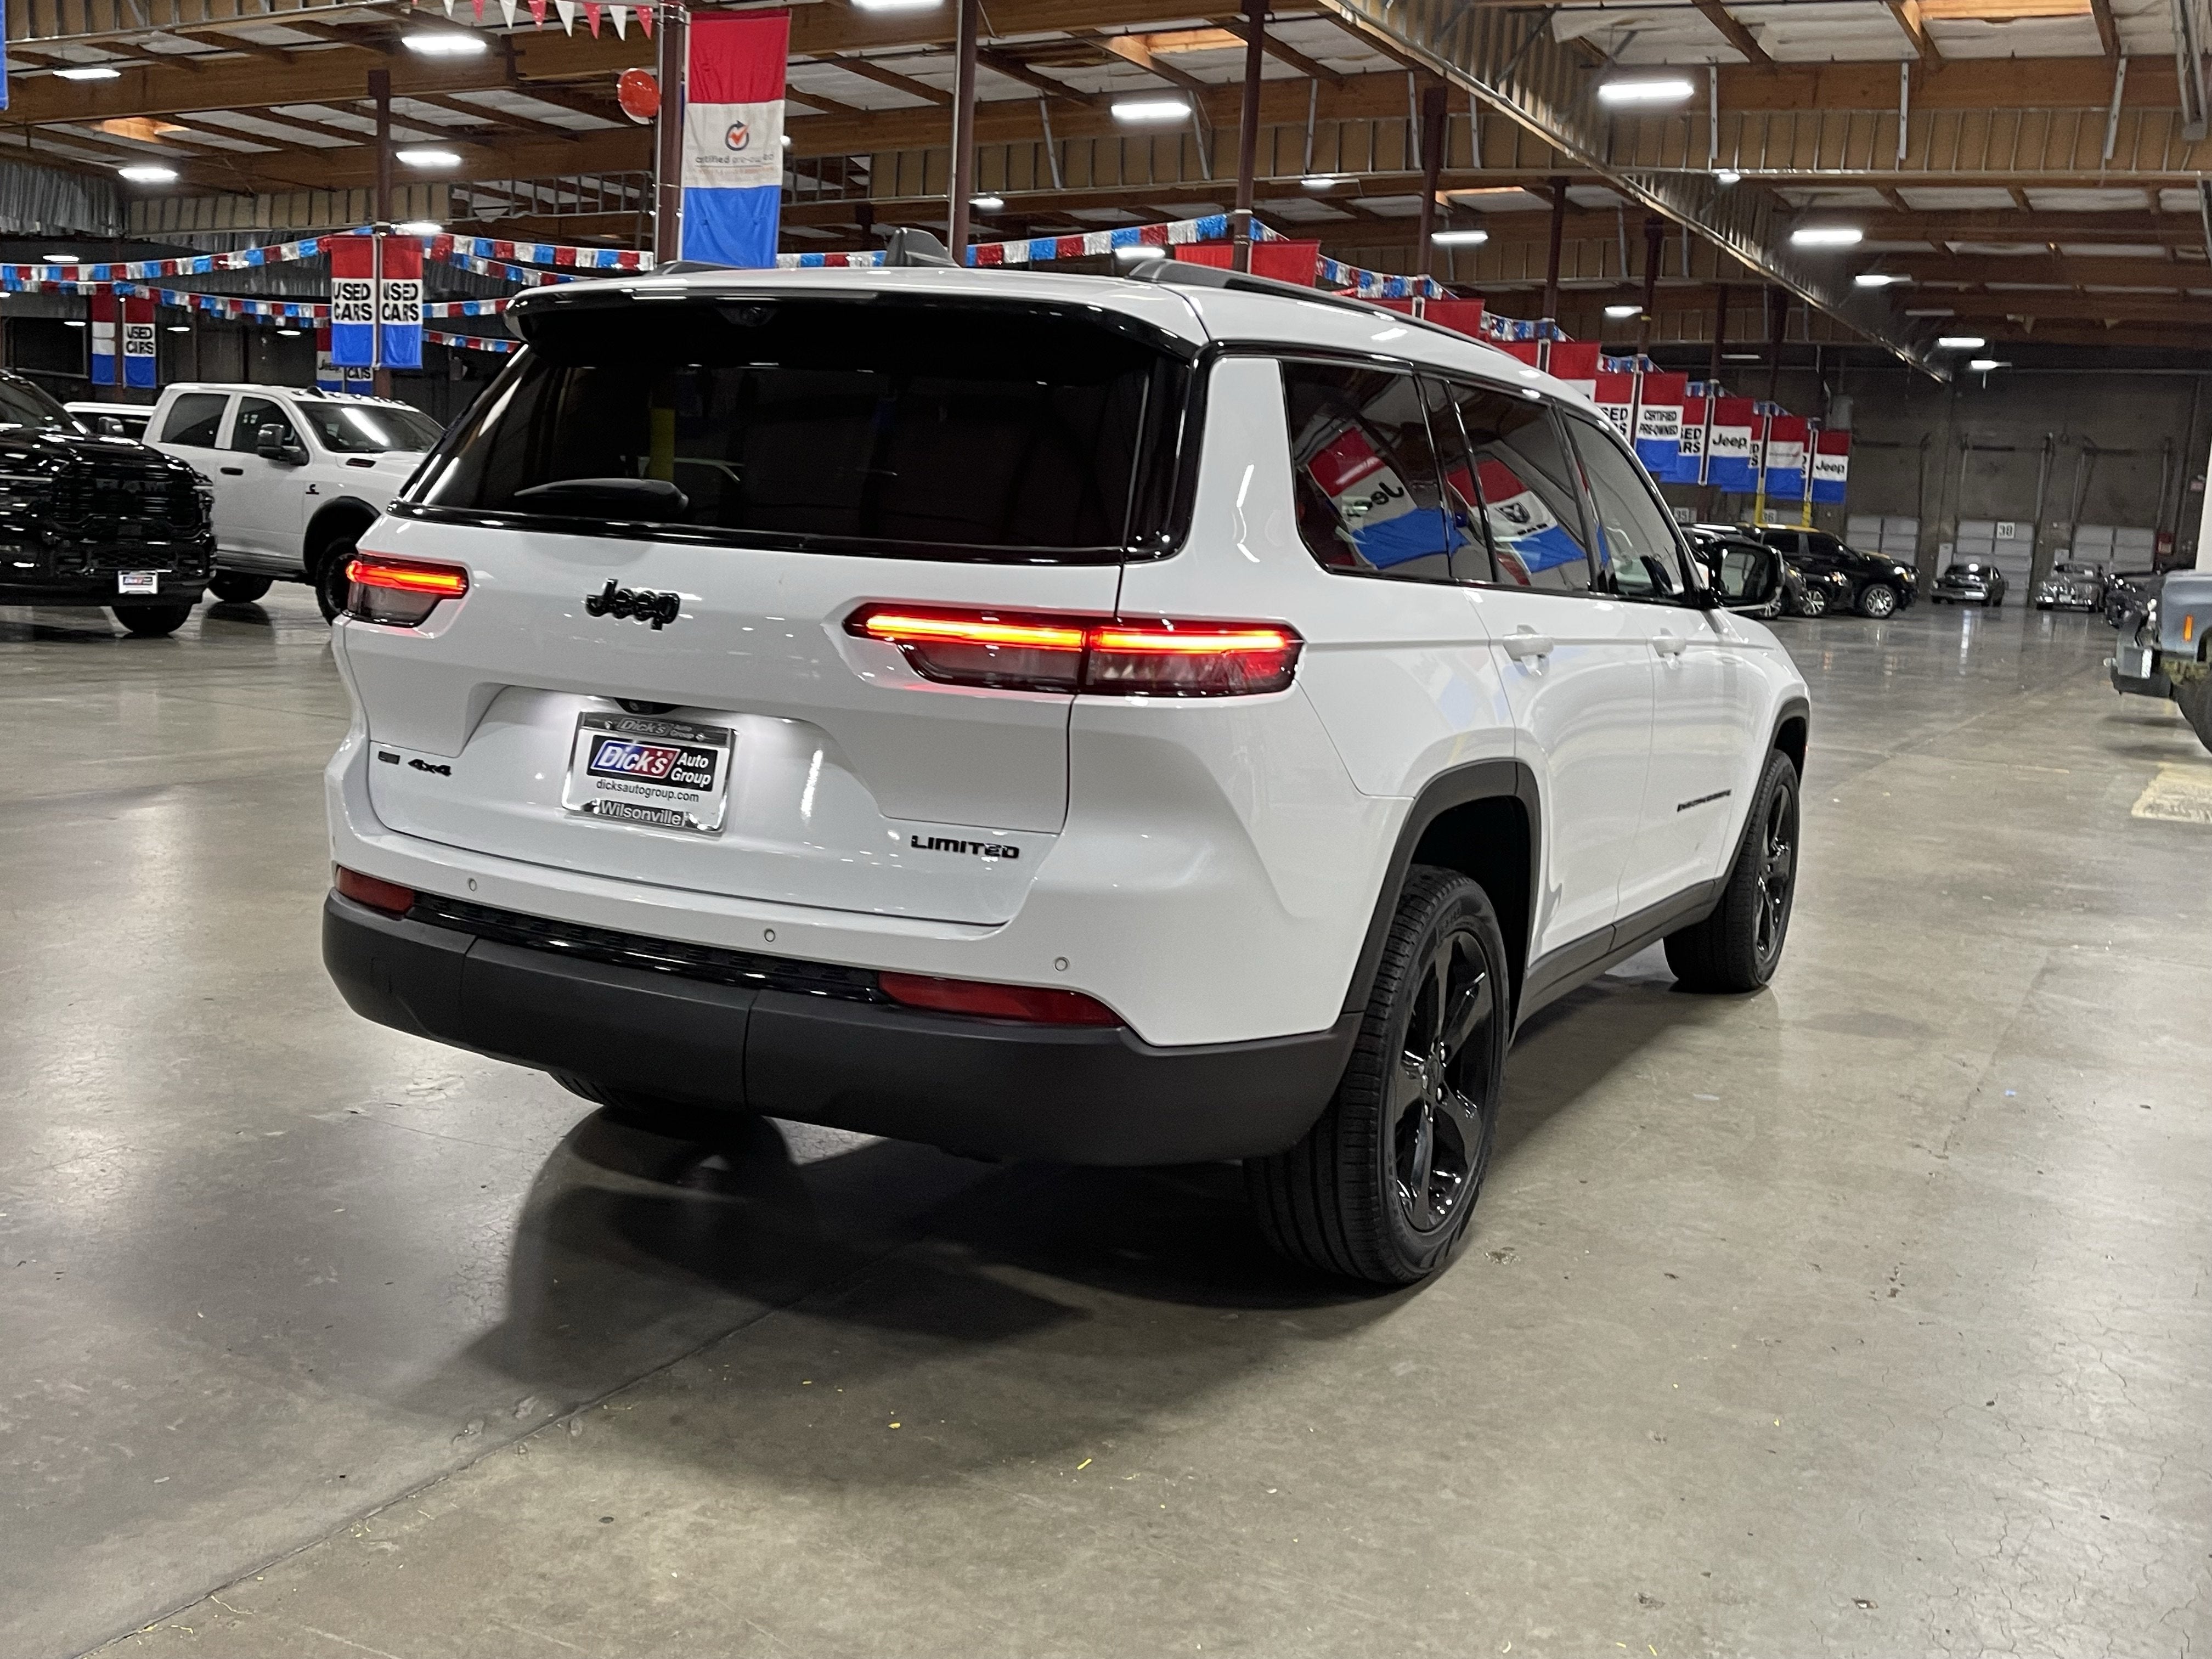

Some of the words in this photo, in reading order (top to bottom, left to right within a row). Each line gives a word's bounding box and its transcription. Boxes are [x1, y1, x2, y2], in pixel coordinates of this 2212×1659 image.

[333, 283, 371, 301] USED
[334, 303, 373, 321] CARS
[382, 303, 419, 321] CARS
[1601, 407, 1628, 421] SED
[1712, 433, 1748, 449] Jeep
[1815, 459, 1845, 475] Jeep
[585, 578, 680, 631] Jeep
[597, 746, 668, 775] Dick's
[676, 752, 709, 769] Auto
[670, 768, 712, 788] Group
[596, 779, 699, 803] dicksautogroup.com
[600, 800, 684, 826] Wilsonville
[911, 835, 1019, 859] LIMITED
